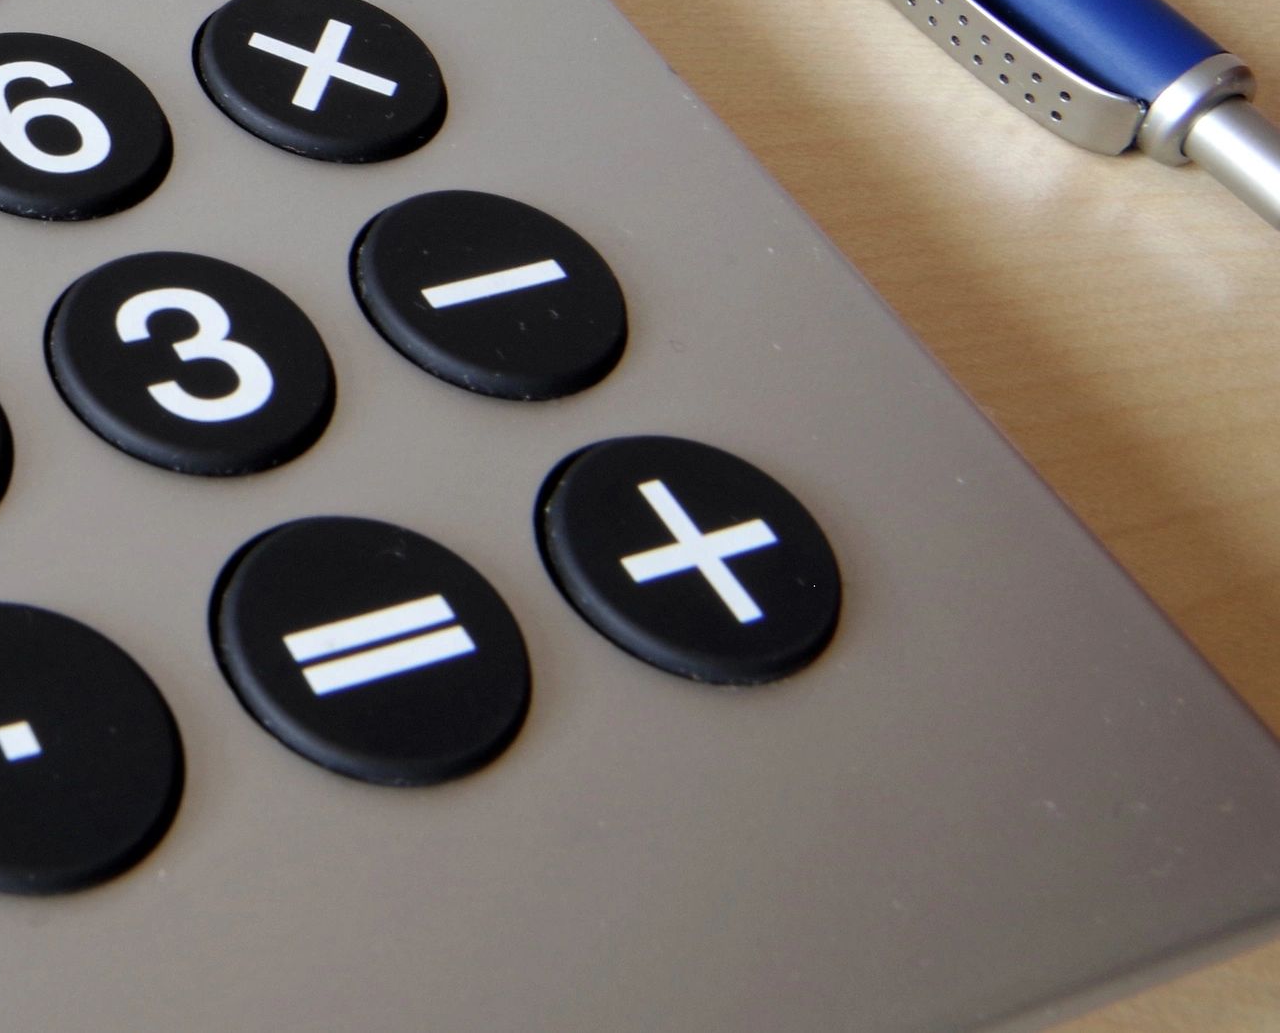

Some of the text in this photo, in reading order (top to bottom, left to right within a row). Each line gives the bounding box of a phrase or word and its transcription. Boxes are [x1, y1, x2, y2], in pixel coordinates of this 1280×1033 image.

[116, 288, 273, 422] 3
[621, 480, 774, 623] +
[284, 595, 474, 694] =
